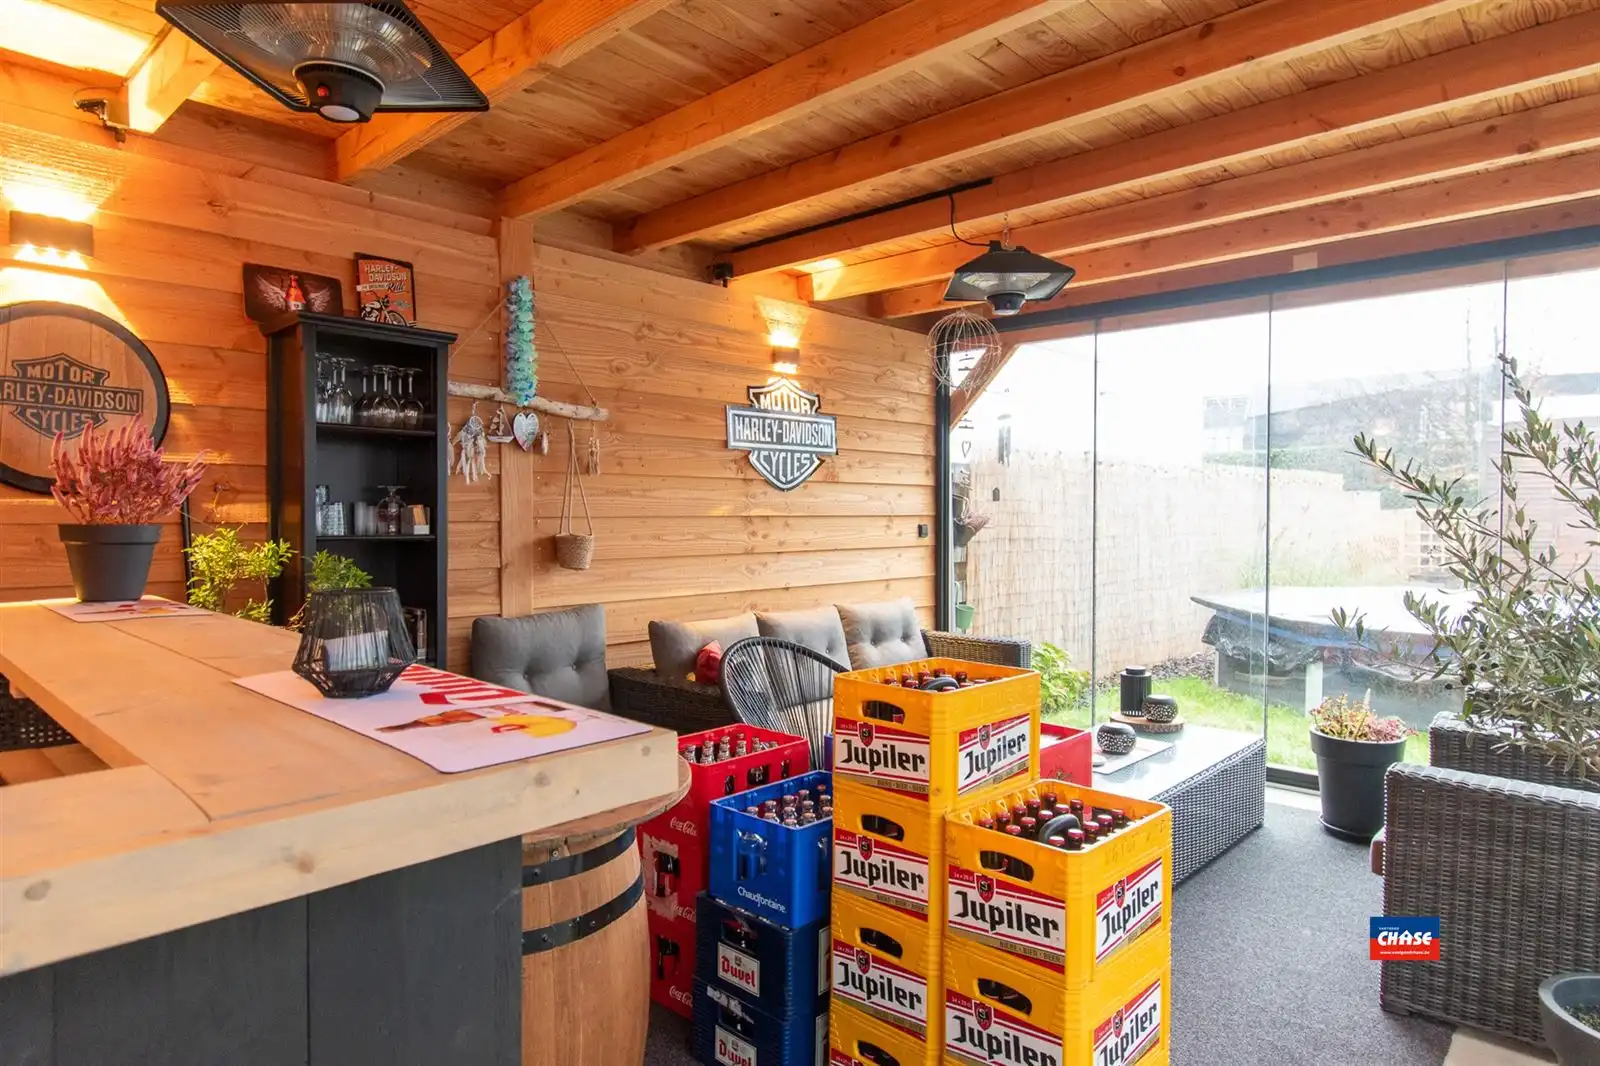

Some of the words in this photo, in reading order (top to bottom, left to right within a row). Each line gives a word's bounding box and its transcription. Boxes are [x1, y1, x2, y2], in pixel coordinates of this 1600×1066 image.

[368, 271, 407, 282] DAVIDSON
[27, 360, 94, 384] MOTOR
[0, 381, 137, 411] RLEY-DAVIDSON
[760, 390, 811, 415] MOTOR
[734, 415, 832, 447] HARLEY-DAVIDSON
[759, 449, 811, 483] CYCLES
[840, 738, 926, 773] Jupiler
[963, 732, 1027, 782] Jupiler
[840, 850, 925, 891] Jupiler
[737, 886, 786, 914] Chaudfontaine
[953, 890, 1060, 939] Jupiler
[1101, 880, 1159, 948] Jupiler
[721, 955, 755, 987] Duvel
[837, 961, 922, 1010] Jupiler
[952, 1015, 1058, 1066] Jupiler
[1099, 1003, 1158, 1066] Jupiler
